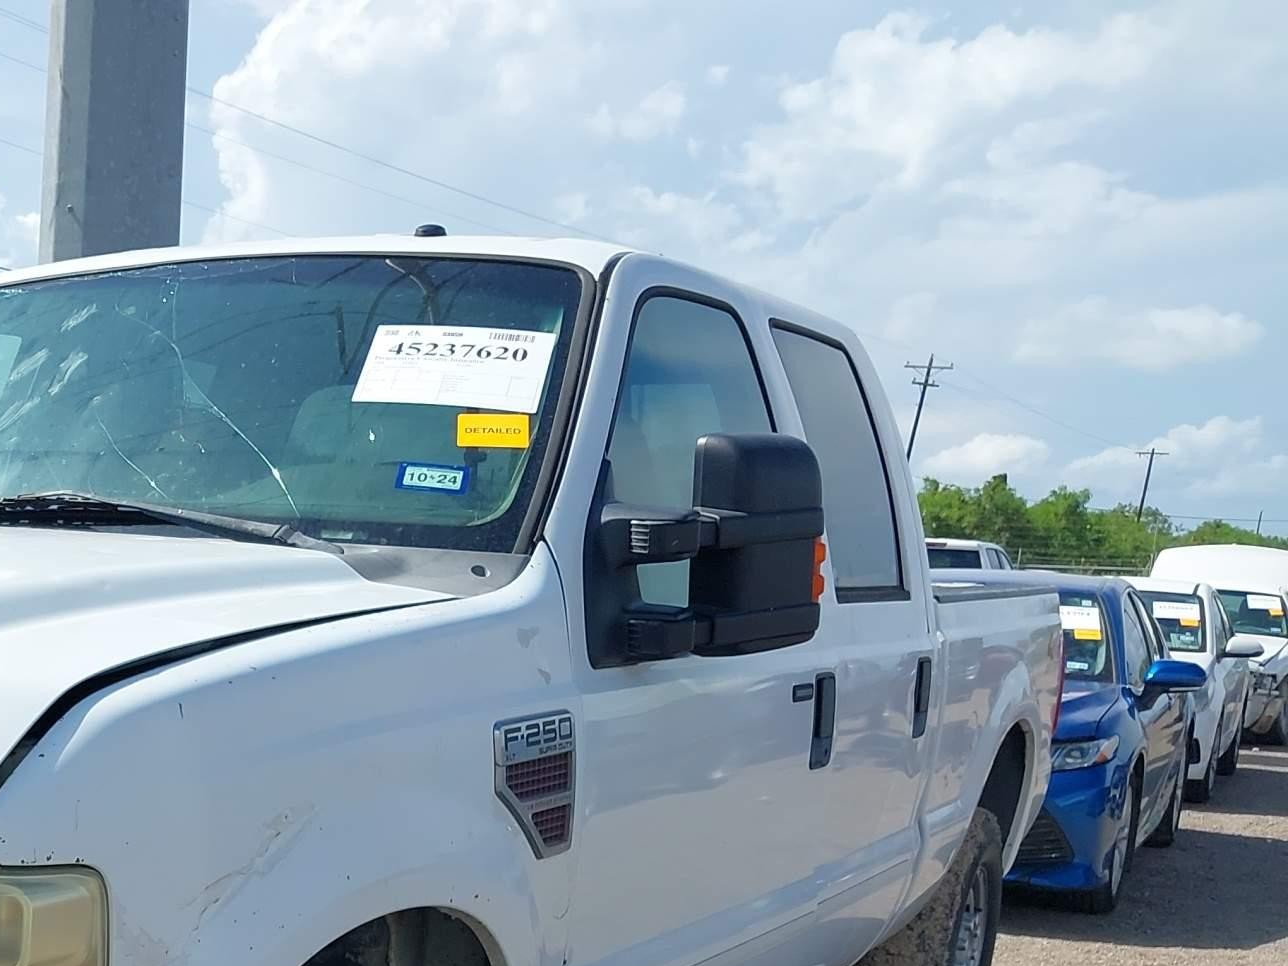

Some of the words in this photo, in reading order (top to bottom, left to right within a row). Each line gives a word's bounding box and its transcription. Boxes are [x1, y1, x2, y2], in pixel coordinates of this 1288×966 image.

[388, 341, 527, 362] 45237620
[464, 426, 521, 435] DETAILED
[504, 717, 572, 752] F-250
